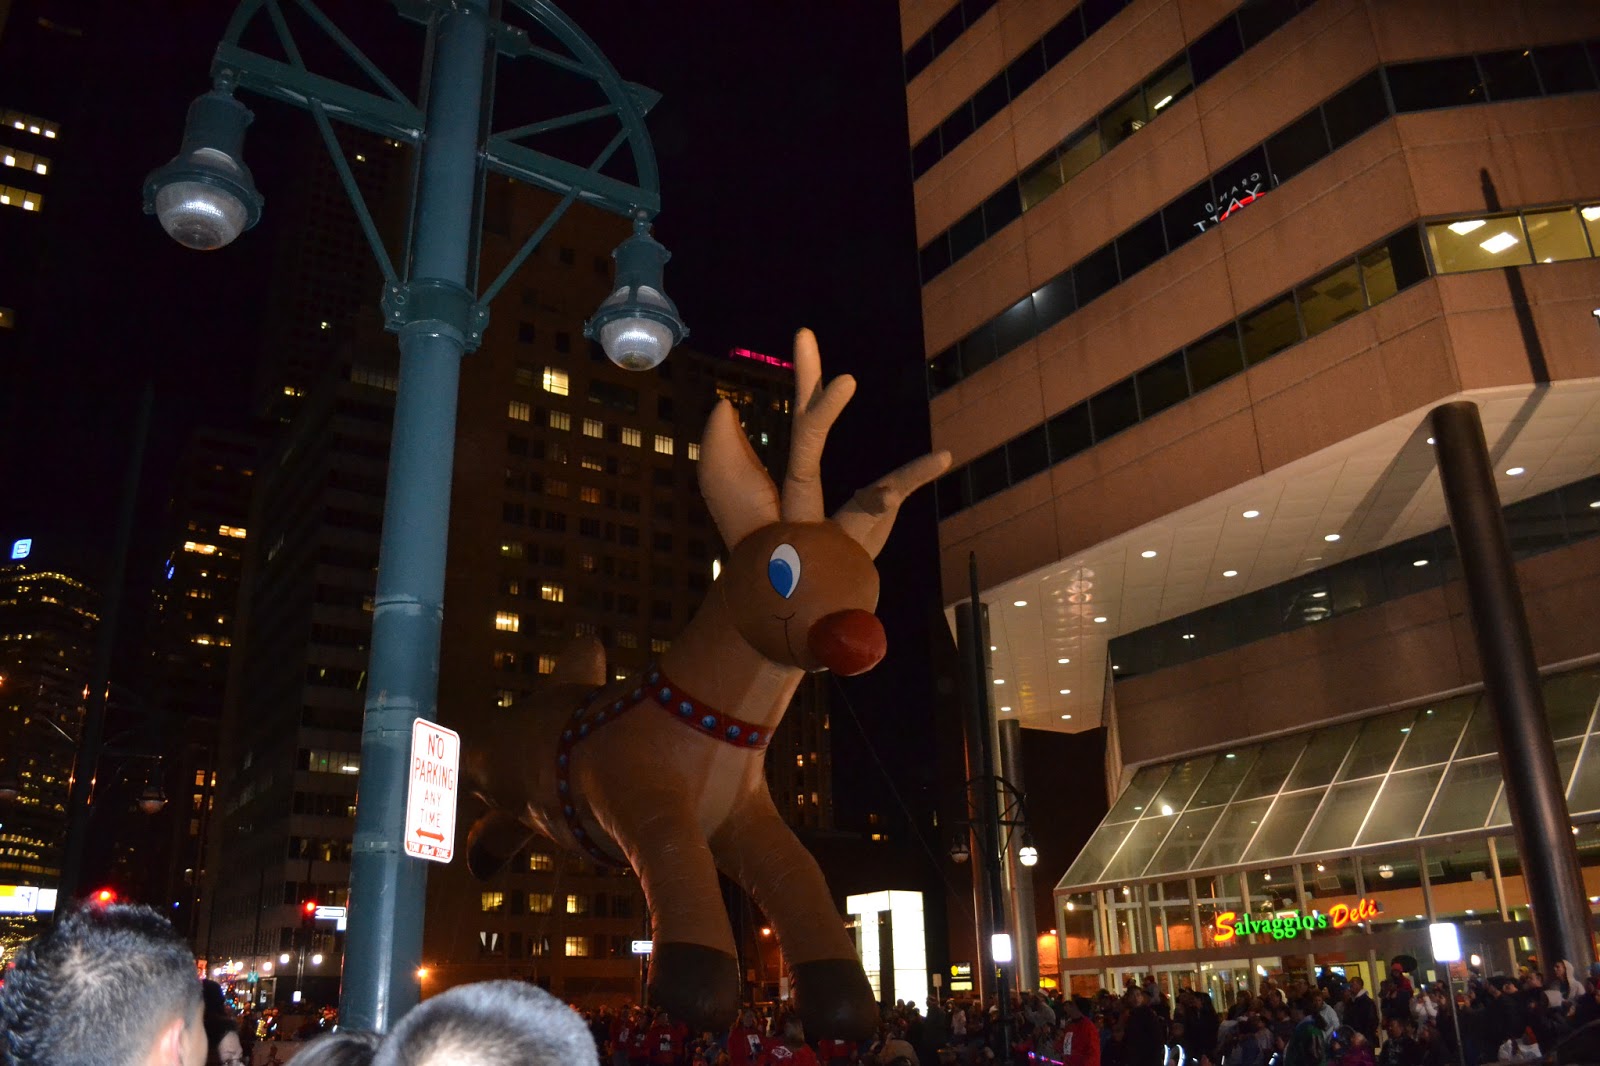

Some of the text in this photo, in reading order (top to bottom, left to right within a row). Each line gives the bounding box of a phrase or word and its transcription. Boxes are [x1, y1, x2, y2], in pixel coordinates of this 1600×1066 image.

[427, 733, 444, 759] NO
[415, 757, 453, 790] PARKING
[424, 789, 442, 807] ANY
[420, 808, 441, 828] TIME
[1329, 898, 1377, 929] Deli
